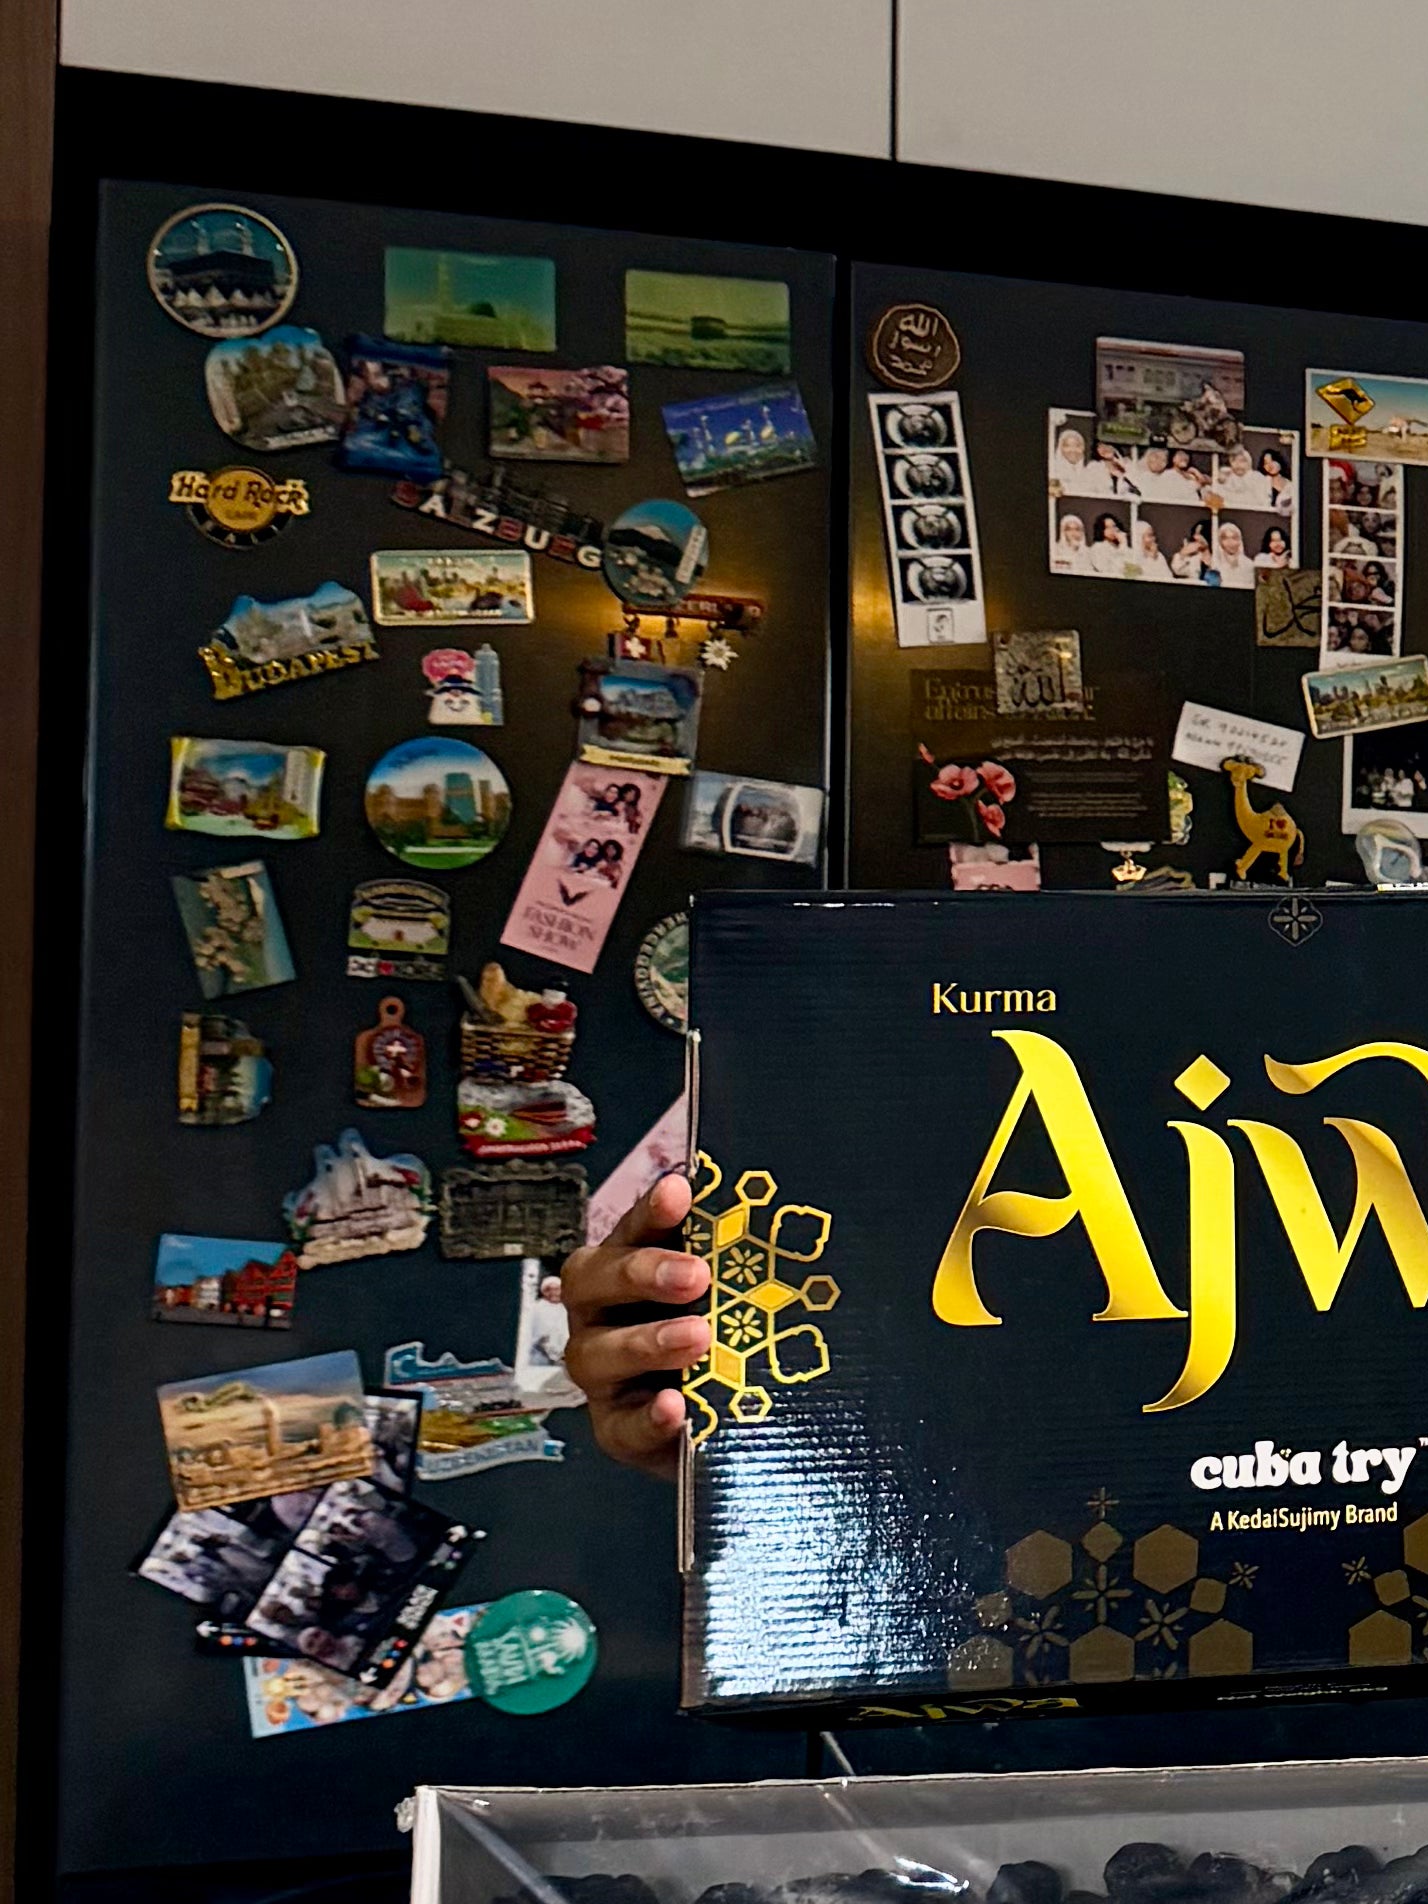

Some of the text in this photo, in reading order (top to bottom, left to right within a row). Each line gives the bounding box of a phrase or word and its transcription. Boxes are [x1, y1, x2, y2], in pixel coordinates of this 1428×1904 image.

[932, 982, 1058, 1016] Kurma
[1190, 1440, 1322, 1490] cuba
[1332, 1439, 1417, 1494] try
[1210, 1501, 1398, 1533] A KedaiSujimy Brand
